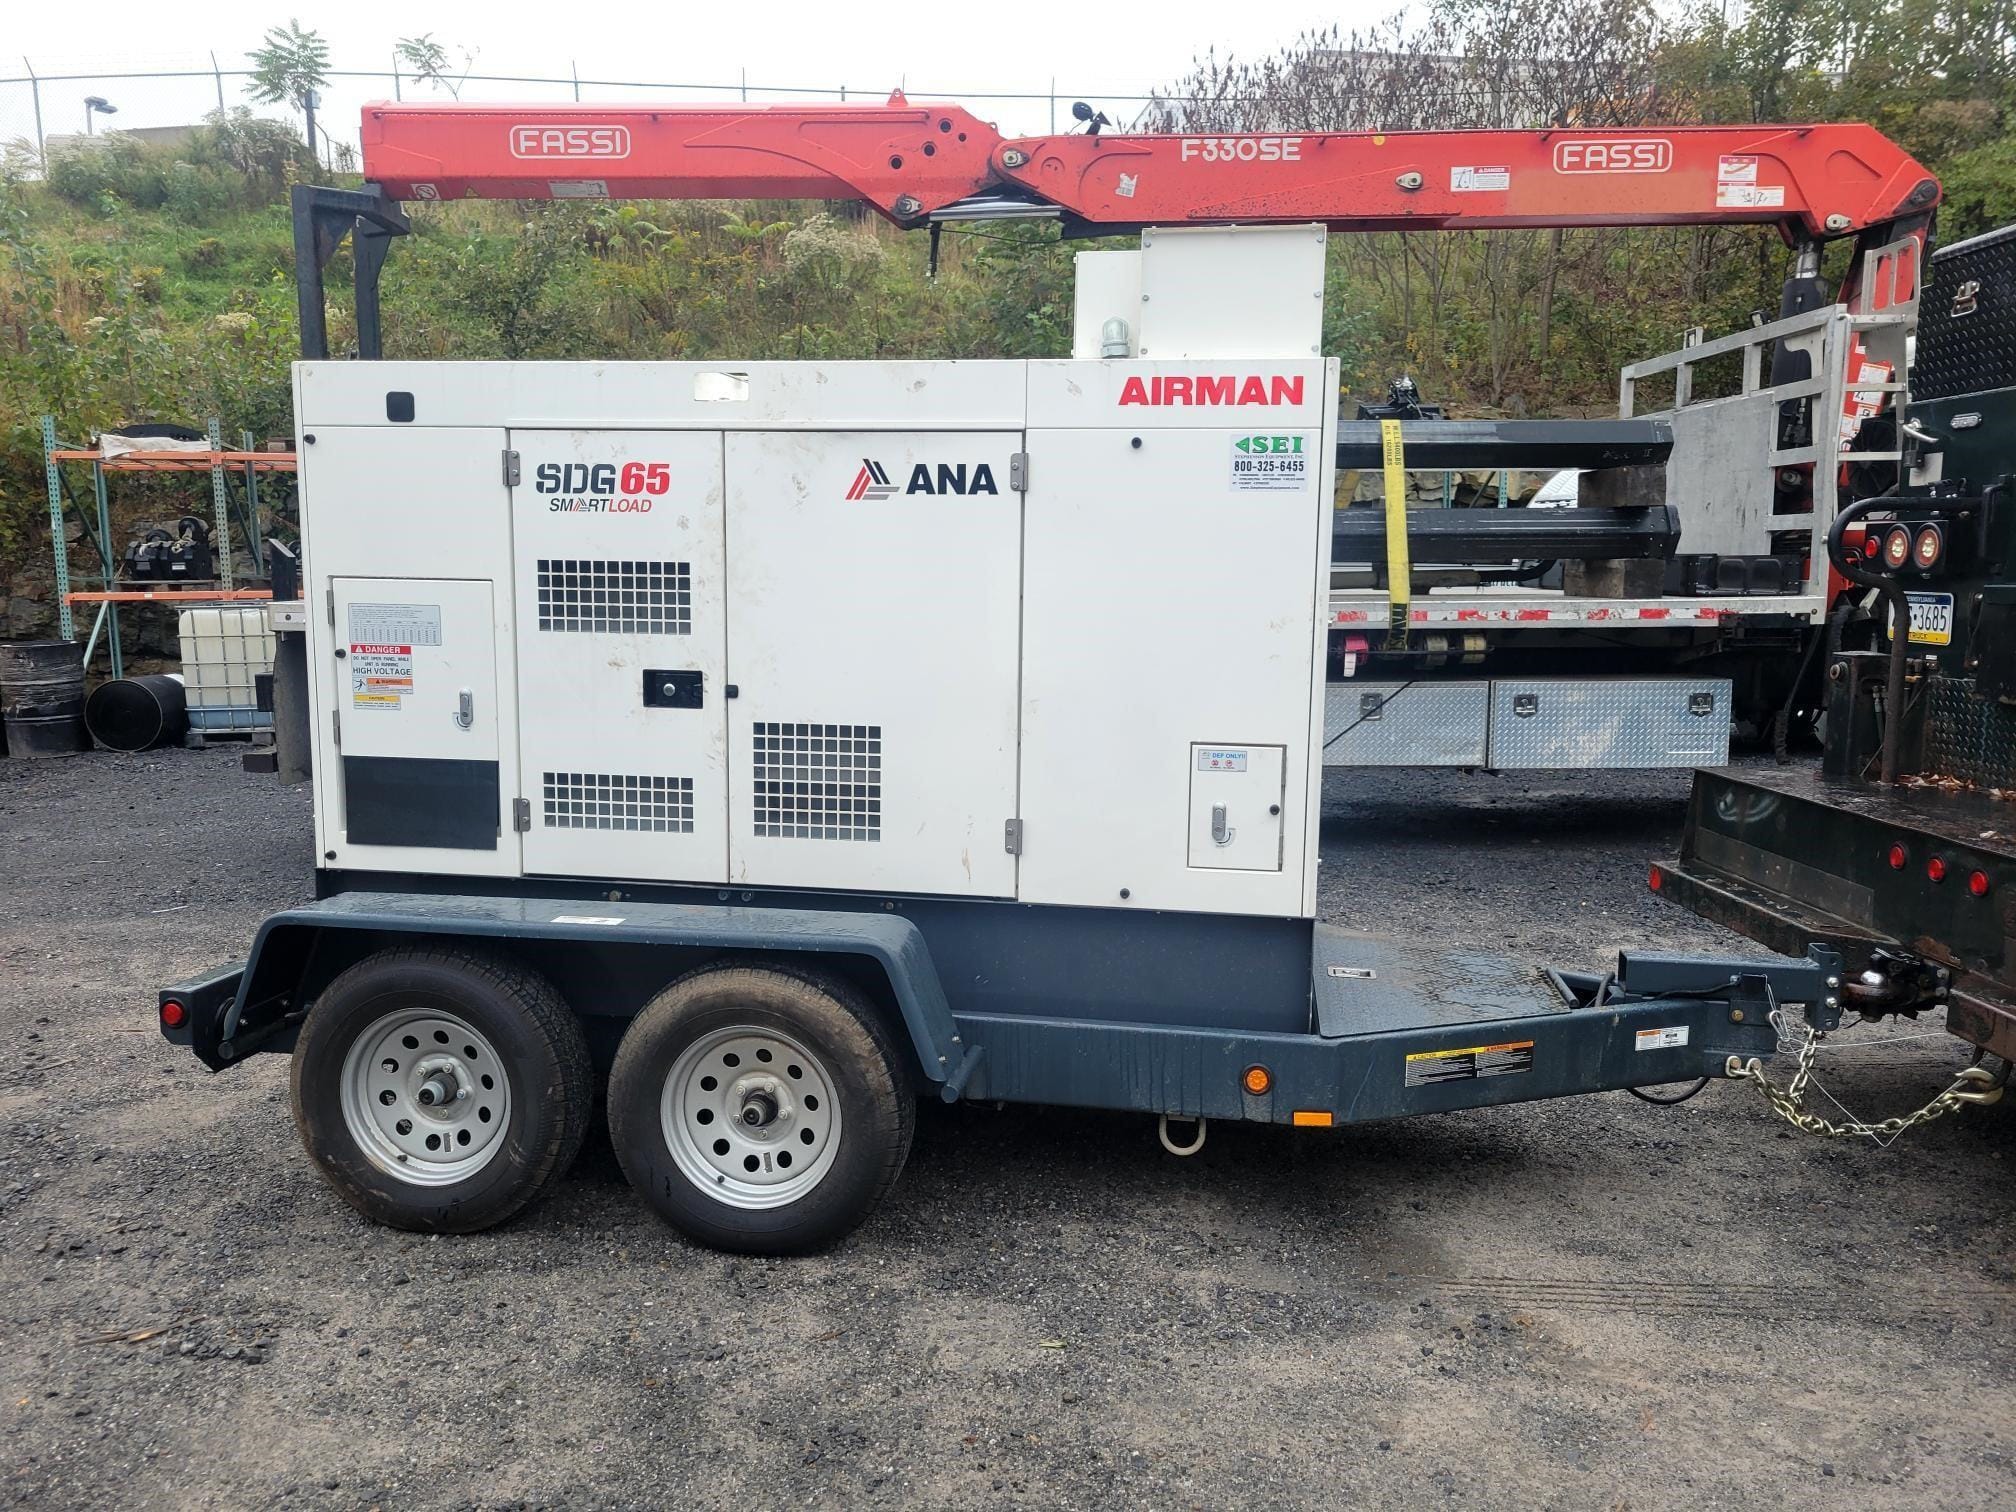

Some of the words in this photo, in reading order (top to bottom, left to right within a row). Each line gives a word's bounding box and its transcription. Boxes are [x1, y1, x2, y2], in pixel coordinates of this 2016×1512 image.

[520, 130, 621, 153] FASSI
[1181, 138, 1303, 161] F330SE
[1563, 144, 1663, 168] FASSI
[1118, 376, 1304, 406] AIRMAN
[1252, 436, 1304, 453] SEI
[1234, 460, 1304, 472] 800-325-6455
[906, 463, 998, 495] ANA
[365, 646, 401, 654] DANGER
[353, 667, 372, 675] HIGH
[374, 667, 412, 676] VOLTAGE
